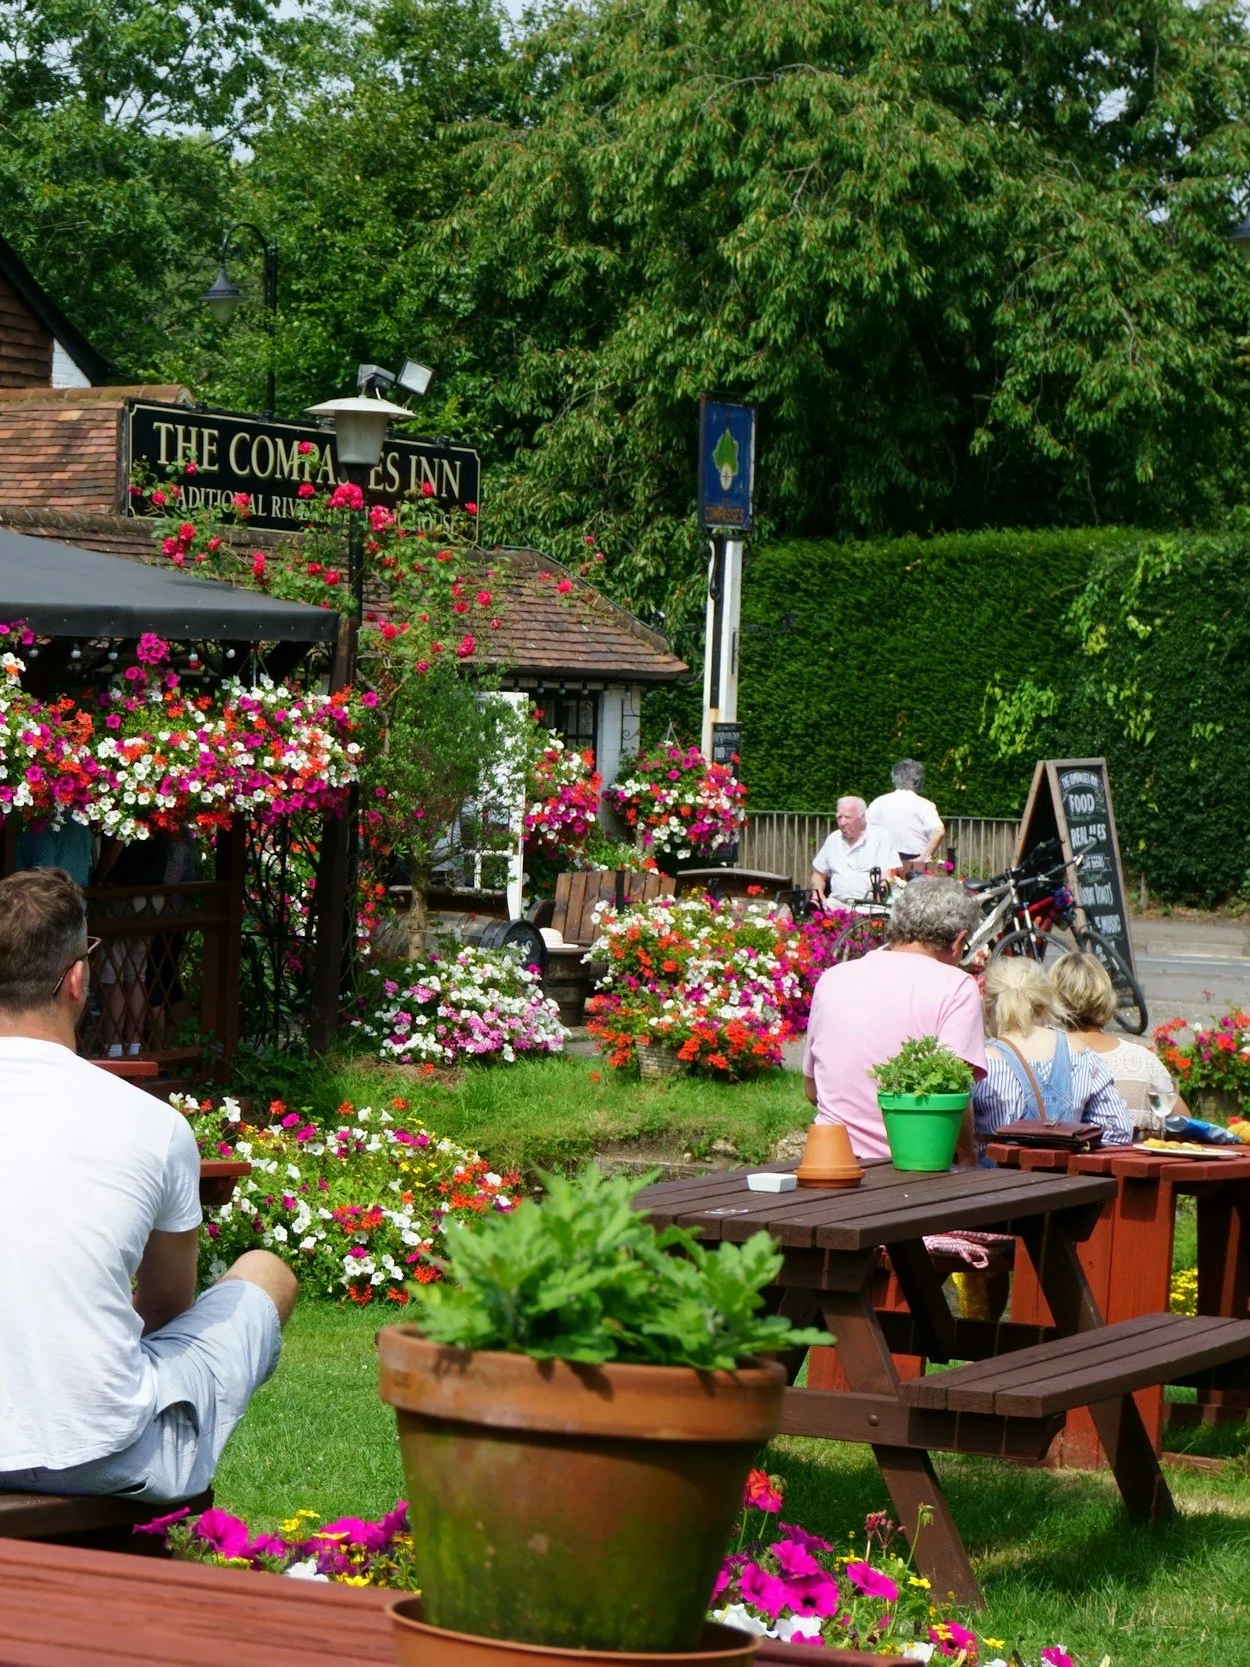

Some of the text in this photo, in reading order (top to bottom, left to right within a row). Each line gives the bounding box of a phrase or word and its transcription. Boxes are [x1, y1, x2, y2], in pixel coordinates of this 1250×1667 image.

[152, 421, 462, 499] THE COMPAES INN
[164, 483, 268, 517] ADITIOAL
[1068, 793, 1096, 815] FOOD
[1070, 823, 1107, 849] REAL ALES
